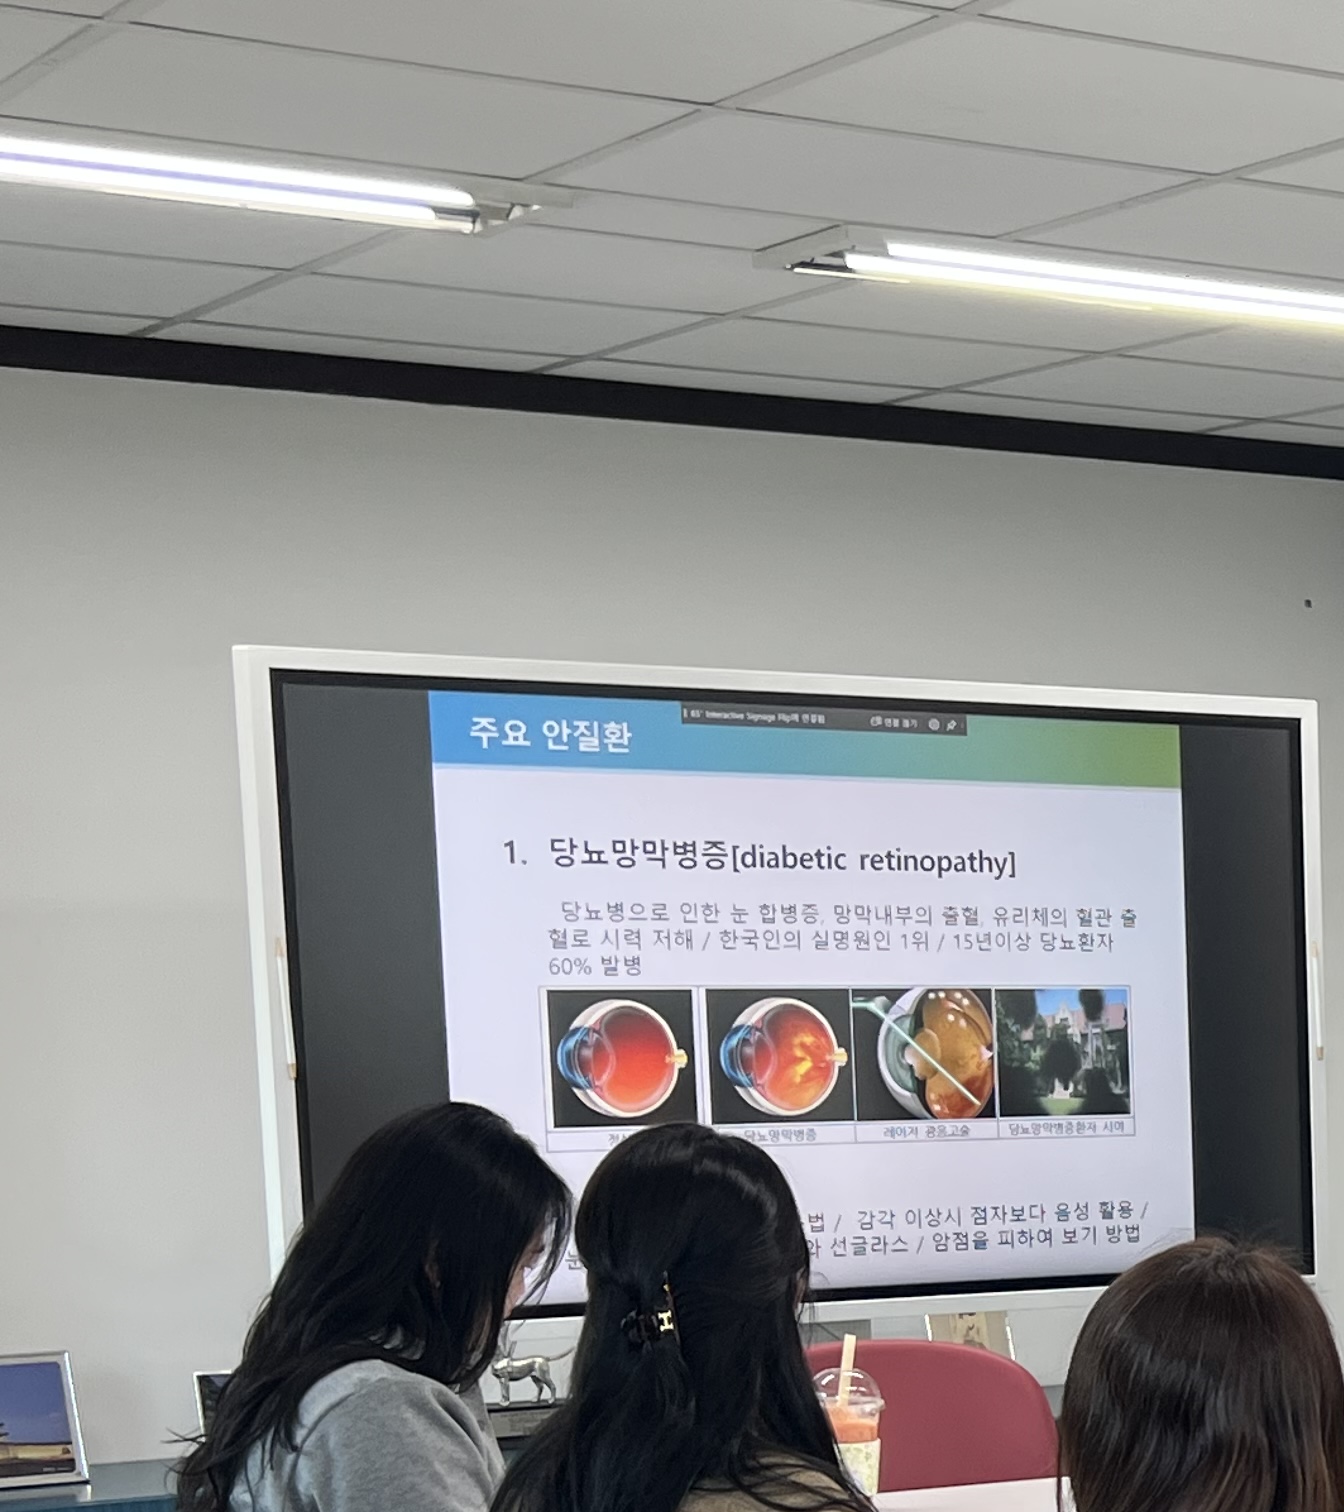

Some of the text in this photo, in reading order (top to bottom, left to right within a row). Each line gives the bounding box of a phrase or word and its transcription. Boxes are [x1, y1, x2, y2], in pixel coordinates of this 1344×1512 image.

[469, 716, 633, 753] 주요 안질환
[503, 838, 1017, 880] 1. 당뇨망막병증[diabetic retinopathy]
[560, 901, 671, 923] 당뇨병으로
[679, 902, 720, 924] 인한
[730, 903, 750, 924] 눈
[833, 904, 933, 926] 망막내부의
[991, 906, 1069, 928] 유리체의
[1075, 907, 1113, 929] 혈관
[547, 928, 592, 950] 혈로
[600, 928, 643, 951] 시력
[652, 928, 695, 951] 저해
[719, 928, 802, 951] 한국인의
[811, 929, 892, 952] 실명원인
[900, 931, 929, 952] 1위
[953, 931, 1032, 952] 15년이상
[1040, 932, 1115, 953] 당뇨환자
[548, 954, 643, 977] 60% 발병
[857, 1210, 896, 1231] 감각
[905, 1206, 963, 1229] 이상시
[970, 1203, 1046, 1227] 점자보다
[1054, 1201, 1091, 1222] 음성
[1099, 1200, 1134, 1221] 활용
[830, 1235, 909, 1259] 선글라스
[932, 1230, 990, 1252] 암점을
[998, 1228, 1053, 1249] 피하여
[1061, 1225, 1097, 1246] 보기
[1105, 1223, 1141, 1244] 방법
